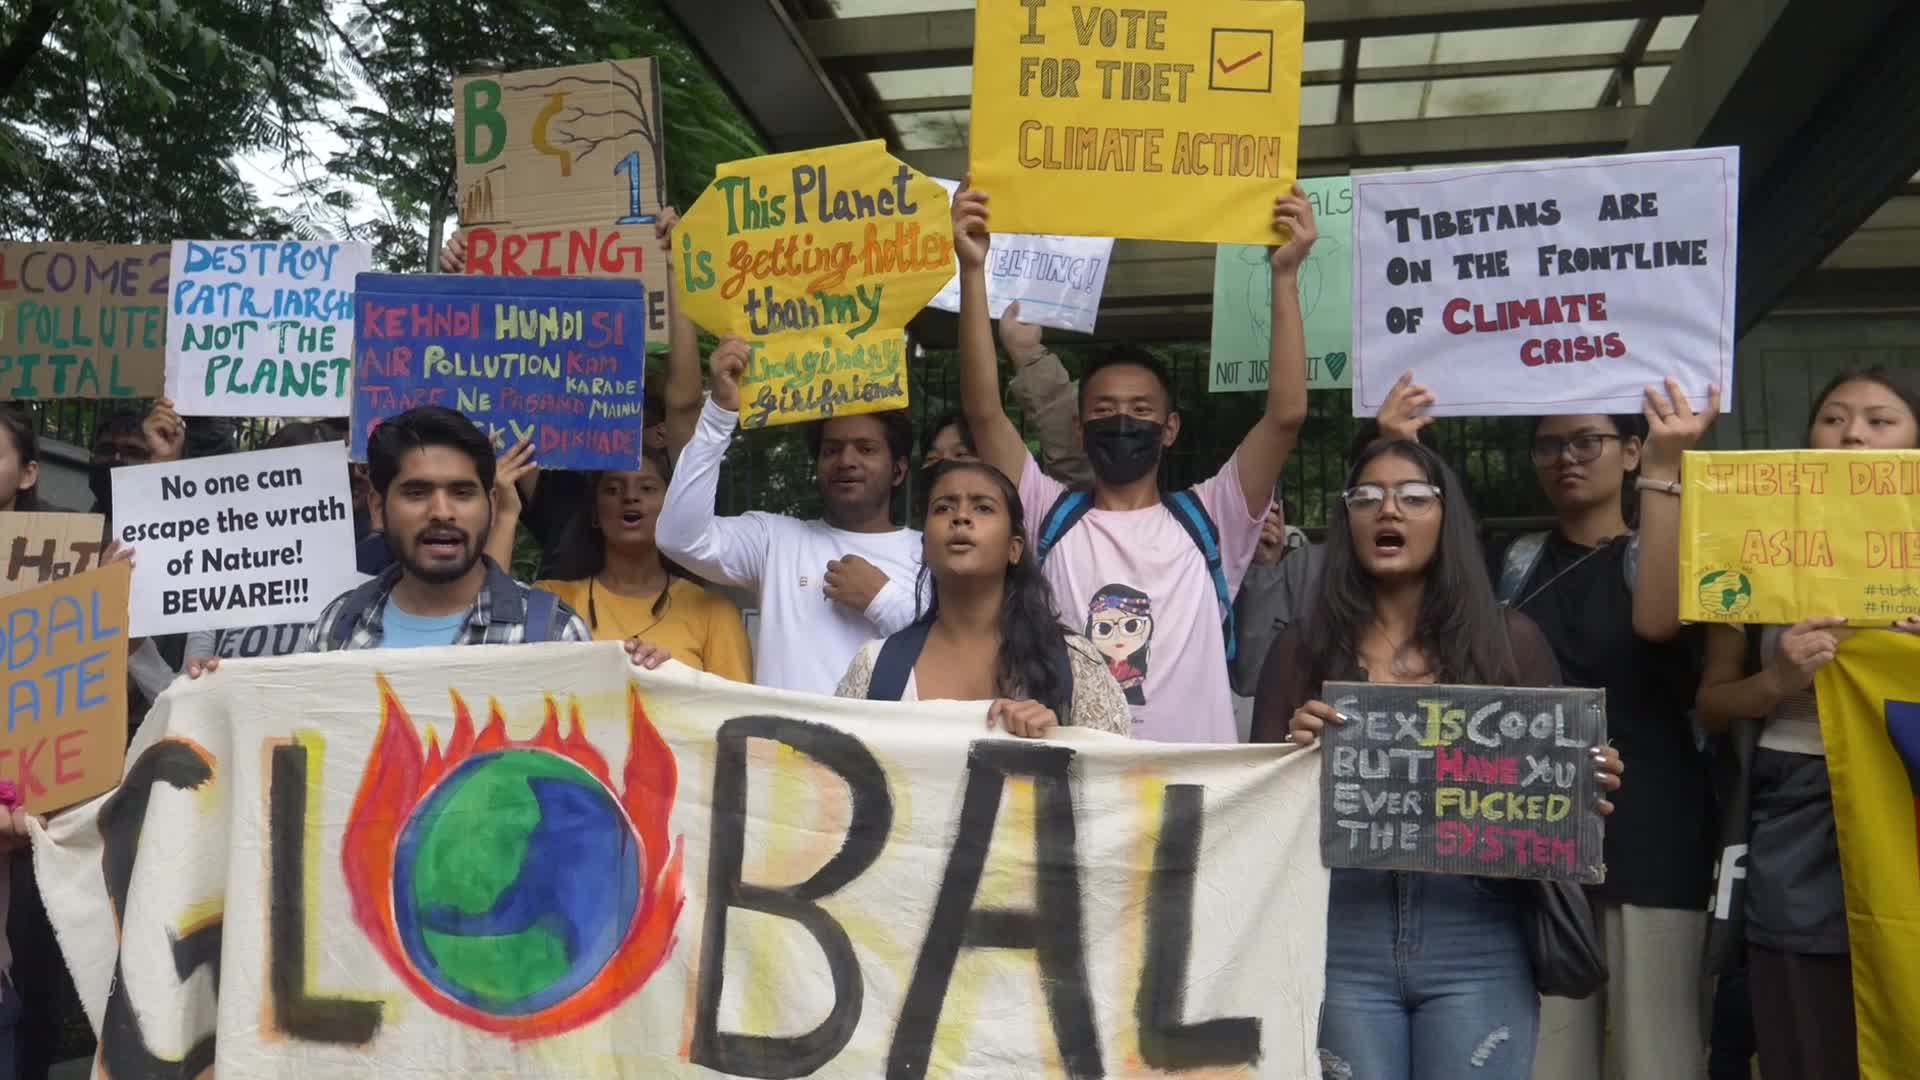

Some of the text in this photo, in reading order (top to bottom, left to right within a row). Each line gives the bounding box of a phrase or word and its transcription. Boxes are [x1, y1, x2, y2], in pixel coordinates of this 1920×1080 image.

[1020, 0, 1168, 50] I VOTE
[1019, 56, 1194, 103] FOR TIBET
[1018, 119, 1281, 178] CLIMATE ACTION
[715, 164, 918, 236] This Planet
[1308, 188, 1352, 216] ALS
[1385, 192, 1658, 244] TIBETANS ARE
[184, 241, 339, 281] DESTROY
[464, 228, 644, 277] BRING
[682, 233, 716, 293] is
[1386, 239, 1708, 286] ON THE FRONTLINE
[17, 300, 168, 348] POLLUTE
[586, 311, 624, 348] SI
[743, 284, 882, 339] than my
[1386, 292, 1608, 335] OF CLIMATE
[182, 321, 336, 354] NOT THE
[1520, 332, 1627, 367] CRISIS
[205, 355, 351, 397] PLANET
[566, 376, 637, 396] KARADE
[1216, 361, 1242, 385] NOT
[1248, 360, 1270, 384] JUS
[161, 467, 303, 501] No one can
[1707, 461, 1920, 496] TIBET DRI
[123, 496, 346, 542] escape the wrath
[167, 539, 304, 576] of Nature!
[1740, 529, 1834, 567] ASIA
[163, 578, 309, 616] BEWARE!!!
[1334, 695, 1425, 742] SEX
[1467, 701, 1590, 748] COOL
[0, 728, 88, 806] KE
[1333, 746, 1576, 788] BUT HAVE YOU
[1333, 782, 1571, 822] EVER FUCKED
[1337, 820, 1578, 872] THE SYSTEM
